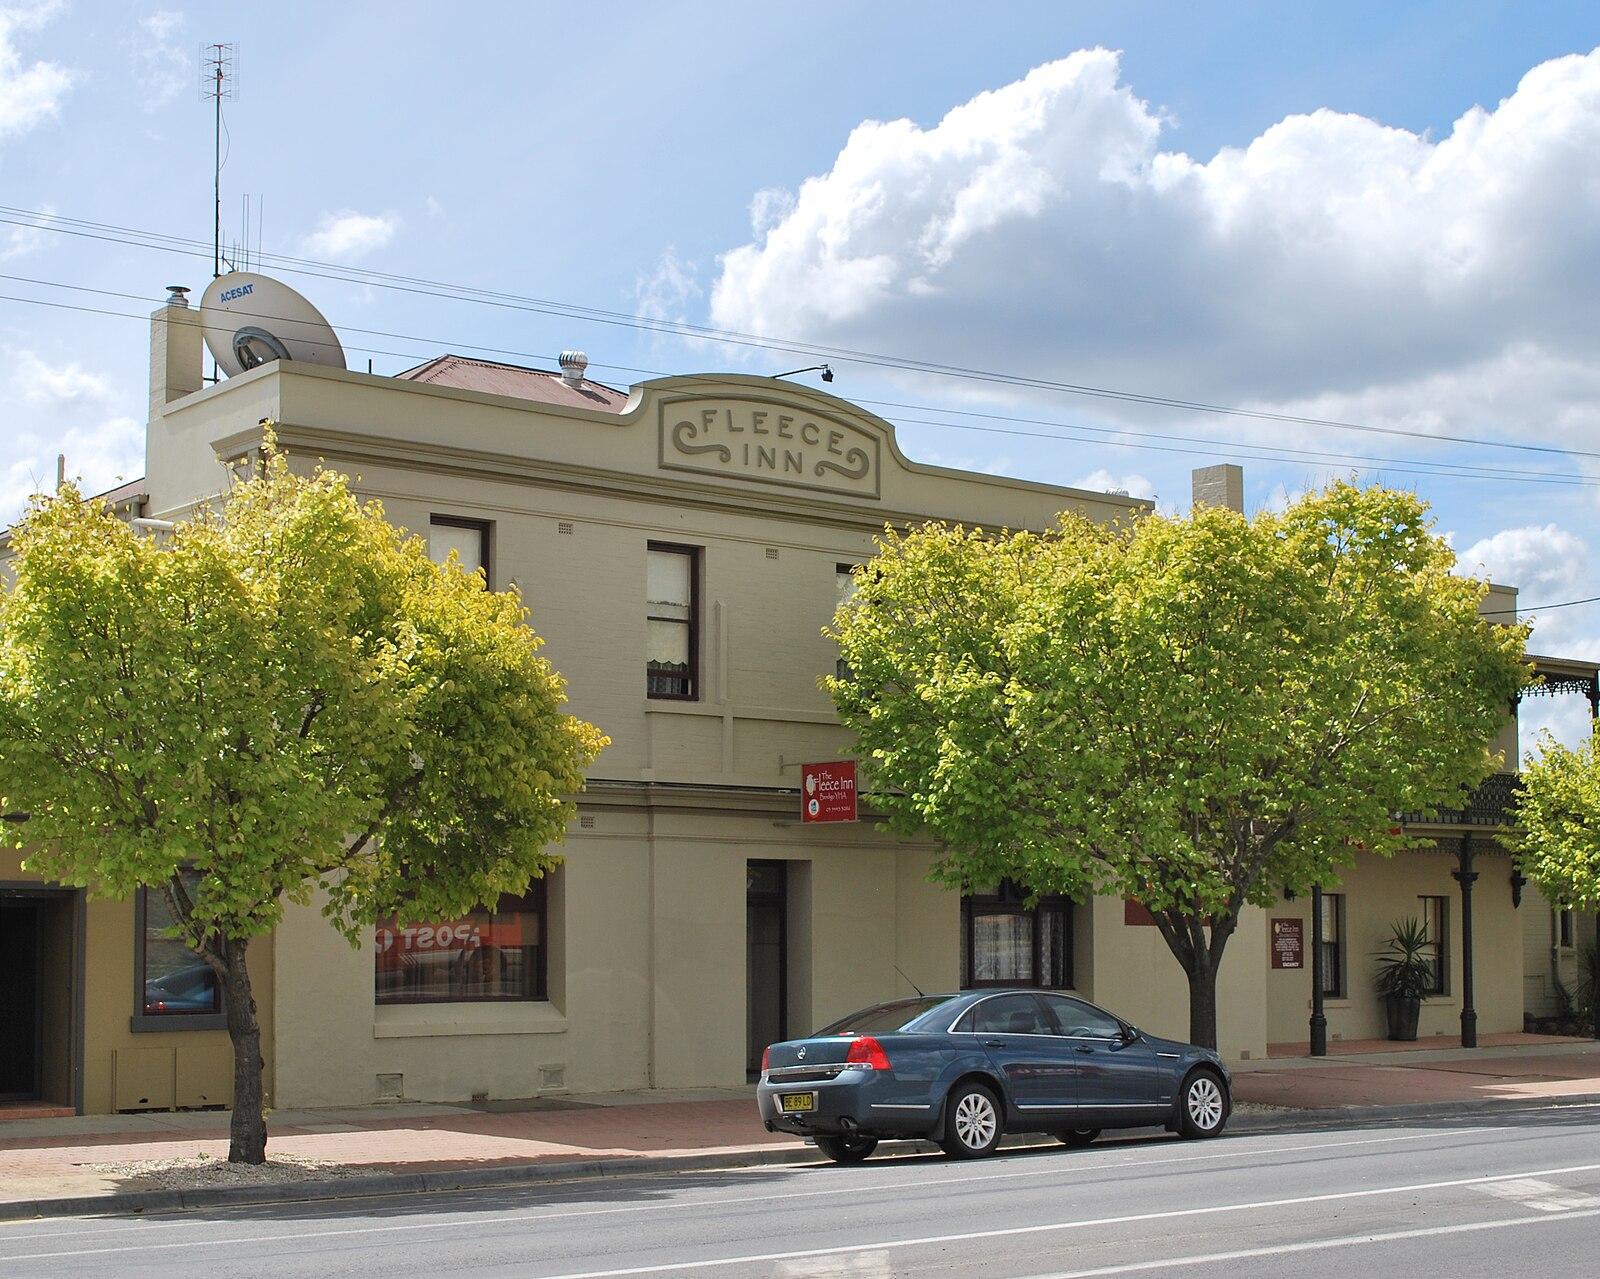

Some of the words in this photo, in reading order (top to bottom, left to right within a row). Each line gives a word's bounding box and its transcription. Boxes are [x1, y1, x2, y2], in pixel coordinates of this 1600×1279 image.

[220, 284, 254, 303] ACESAT
[701, 410, 844, 455] FLEECE
[744, 444, 802, 473] INN
[814, 774, 839, 791] Fleece
[840, 777, 853, 790] Inn
[822, 771, 832, 780] The
